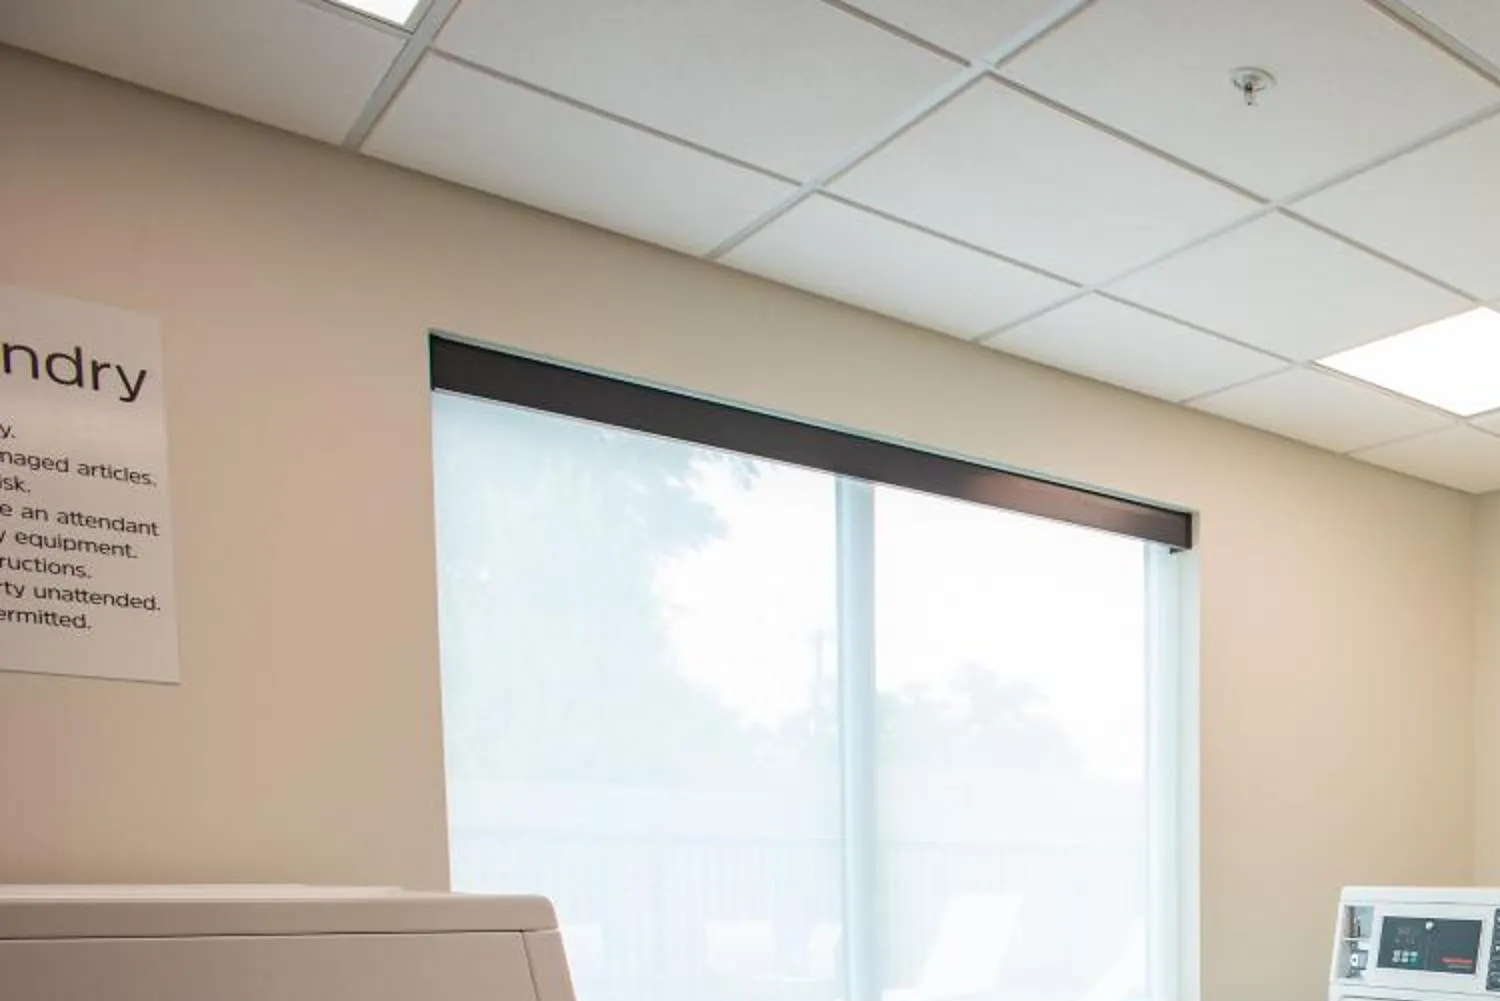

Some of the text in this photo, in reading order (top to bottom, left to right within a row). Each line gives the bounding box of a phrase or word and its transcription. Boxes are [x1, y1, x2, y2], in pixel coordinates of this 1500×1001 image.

[3, 343, 147, 403] ndry
[77, 463, 156, 487] articles.
[21, 506, 48, 521] an
[57, 510, 160, 536] attendant
[15, 531, 138, 558] equipment.
[33, 586, 160, 611] unattended.
